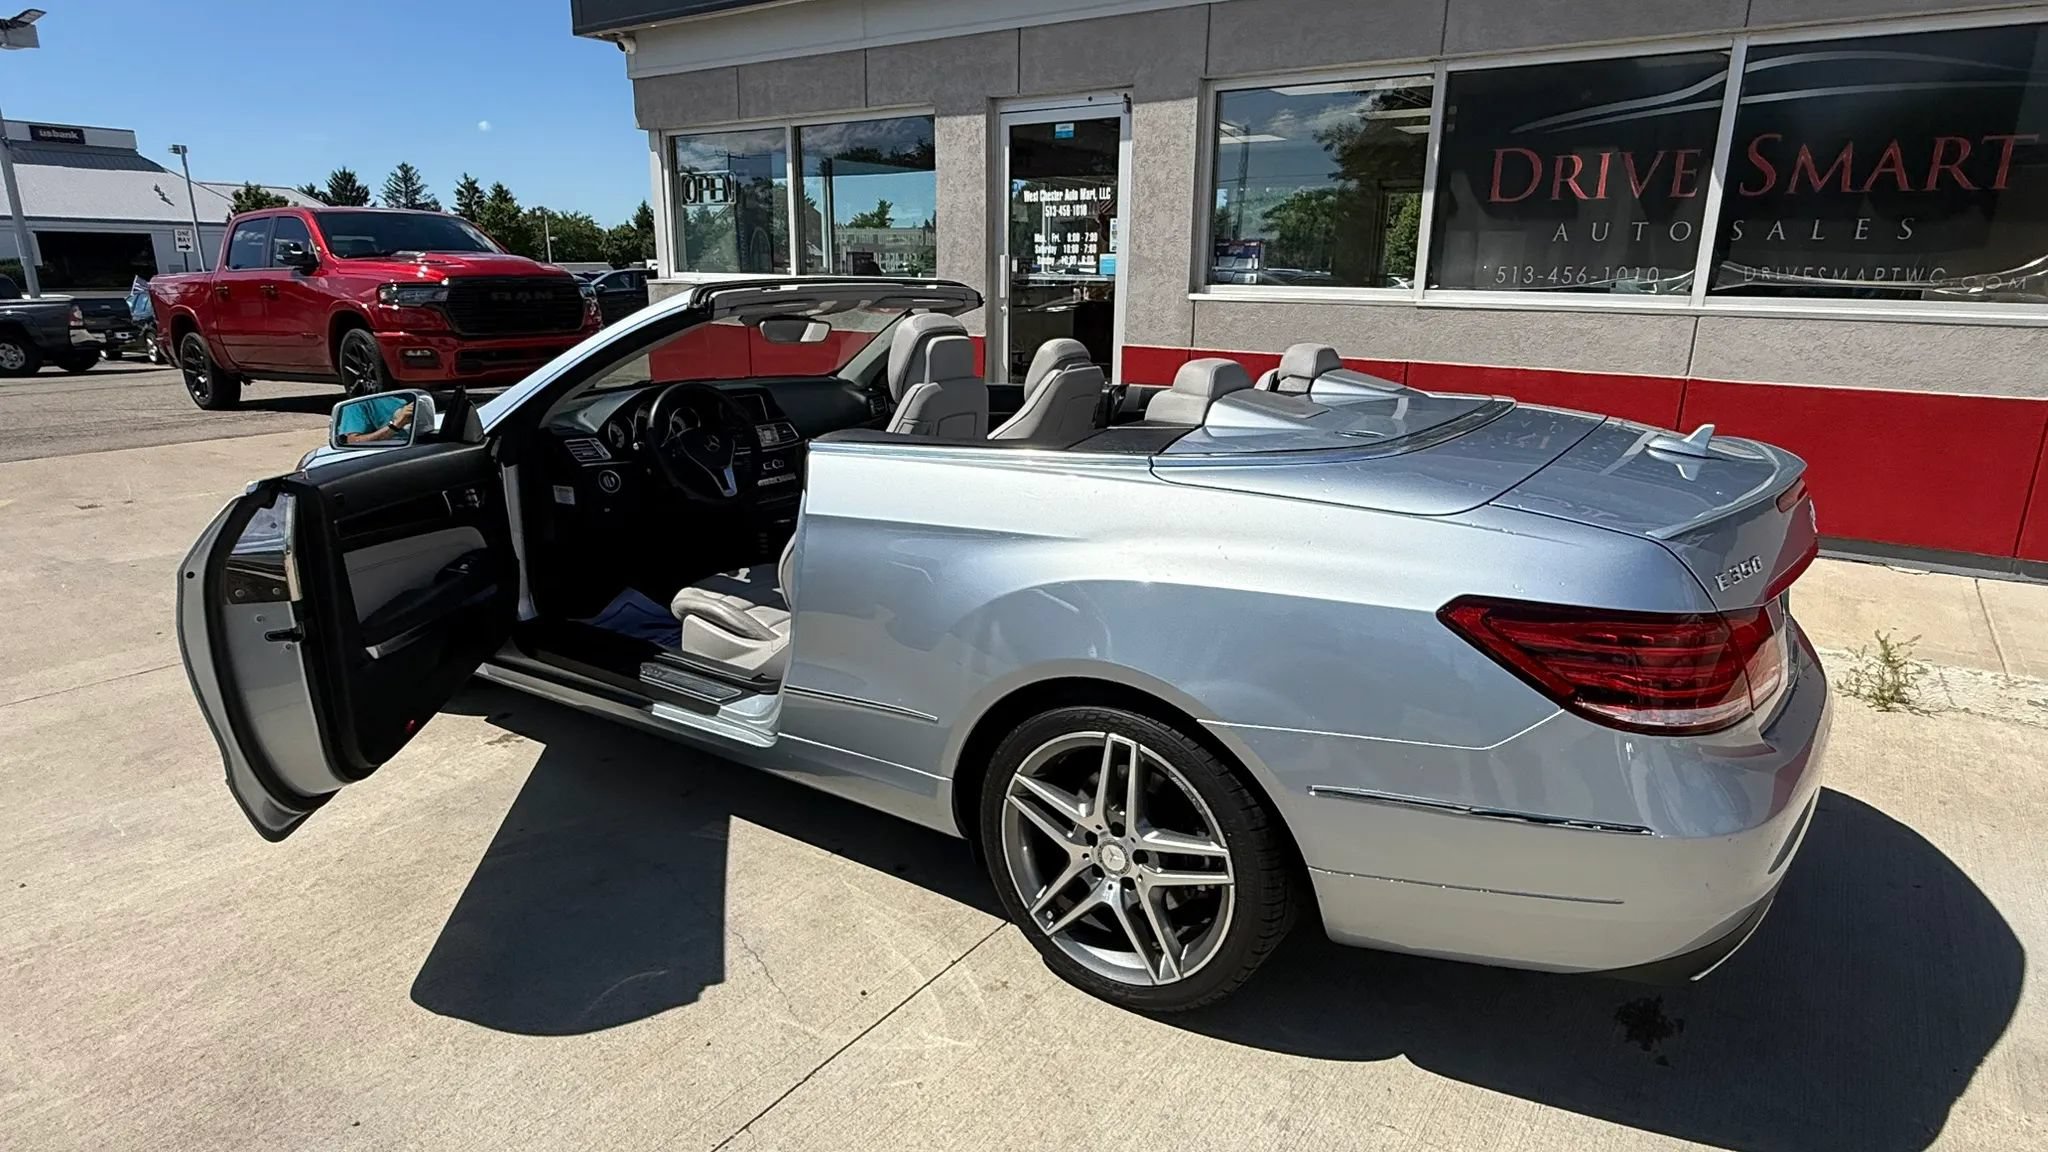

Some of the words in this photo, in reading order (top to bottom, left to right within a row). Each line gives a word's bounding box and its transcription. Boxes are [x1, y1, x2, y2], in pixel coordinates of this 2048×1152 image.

[1489, 148, 1702, 202] DRIVE
[1739, 133, 2040, 196] SMART
[683, 175, 734, 203] OPEN
[1023, 190, 1039, 203] West
[1039, 190, 1063, 202] Chester
[1064, 188, 1079, 201] Auto
[1080, 187, 1098, 201] Mart,
[1099, 187, 1111, 200] LLC
[1045, 204, 1088, 217] 513-456-1010
[1552, 220, 1692, 242] AUTO
[1730, 217, 1915, 241] SALES
[1495, 265, 1659, 284] 513-456-1010
[491, 292, 553, 301] RAM
[1715, 573, 1730, 592] E
[1729, 555, 1763, 585] 350
